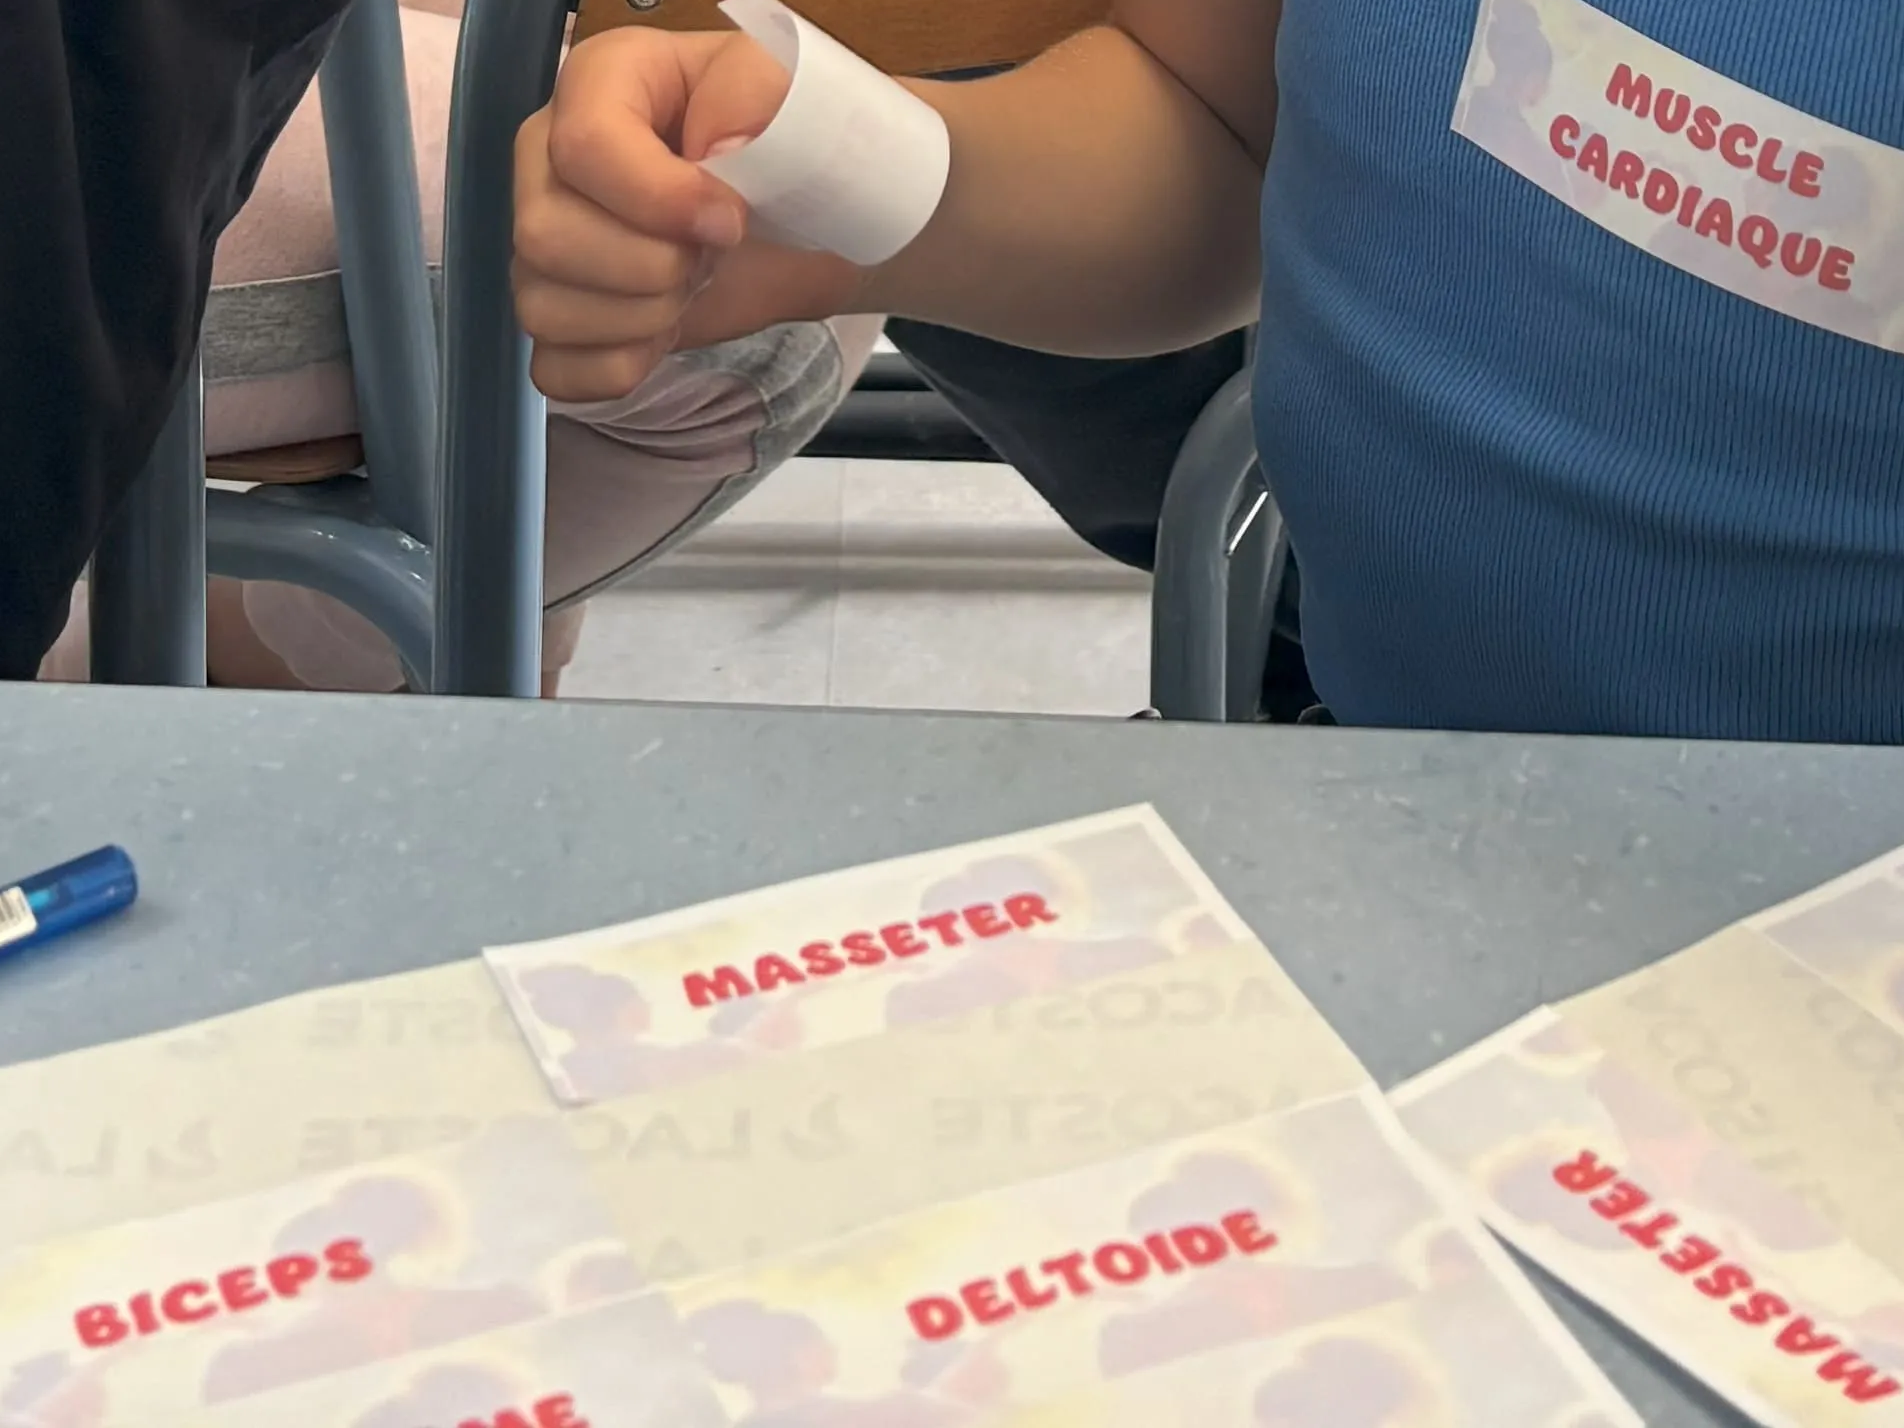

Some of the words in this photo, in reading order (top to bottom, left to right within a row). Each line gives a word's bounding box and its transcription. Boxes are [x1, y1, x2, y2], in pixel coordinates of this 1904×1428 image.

[1605, 62, 1825, 199] MUSCLE
[1549, 113, 1855, 292] CARDIAQUE
[681, 892, 1057, 1009] MASSETER
[72, 1237, 374, 1350] BICEPS
[904, 1208, 1280, 1343] DELTOIDE
[1551, 1149, 1903, 1405] MASSETER
